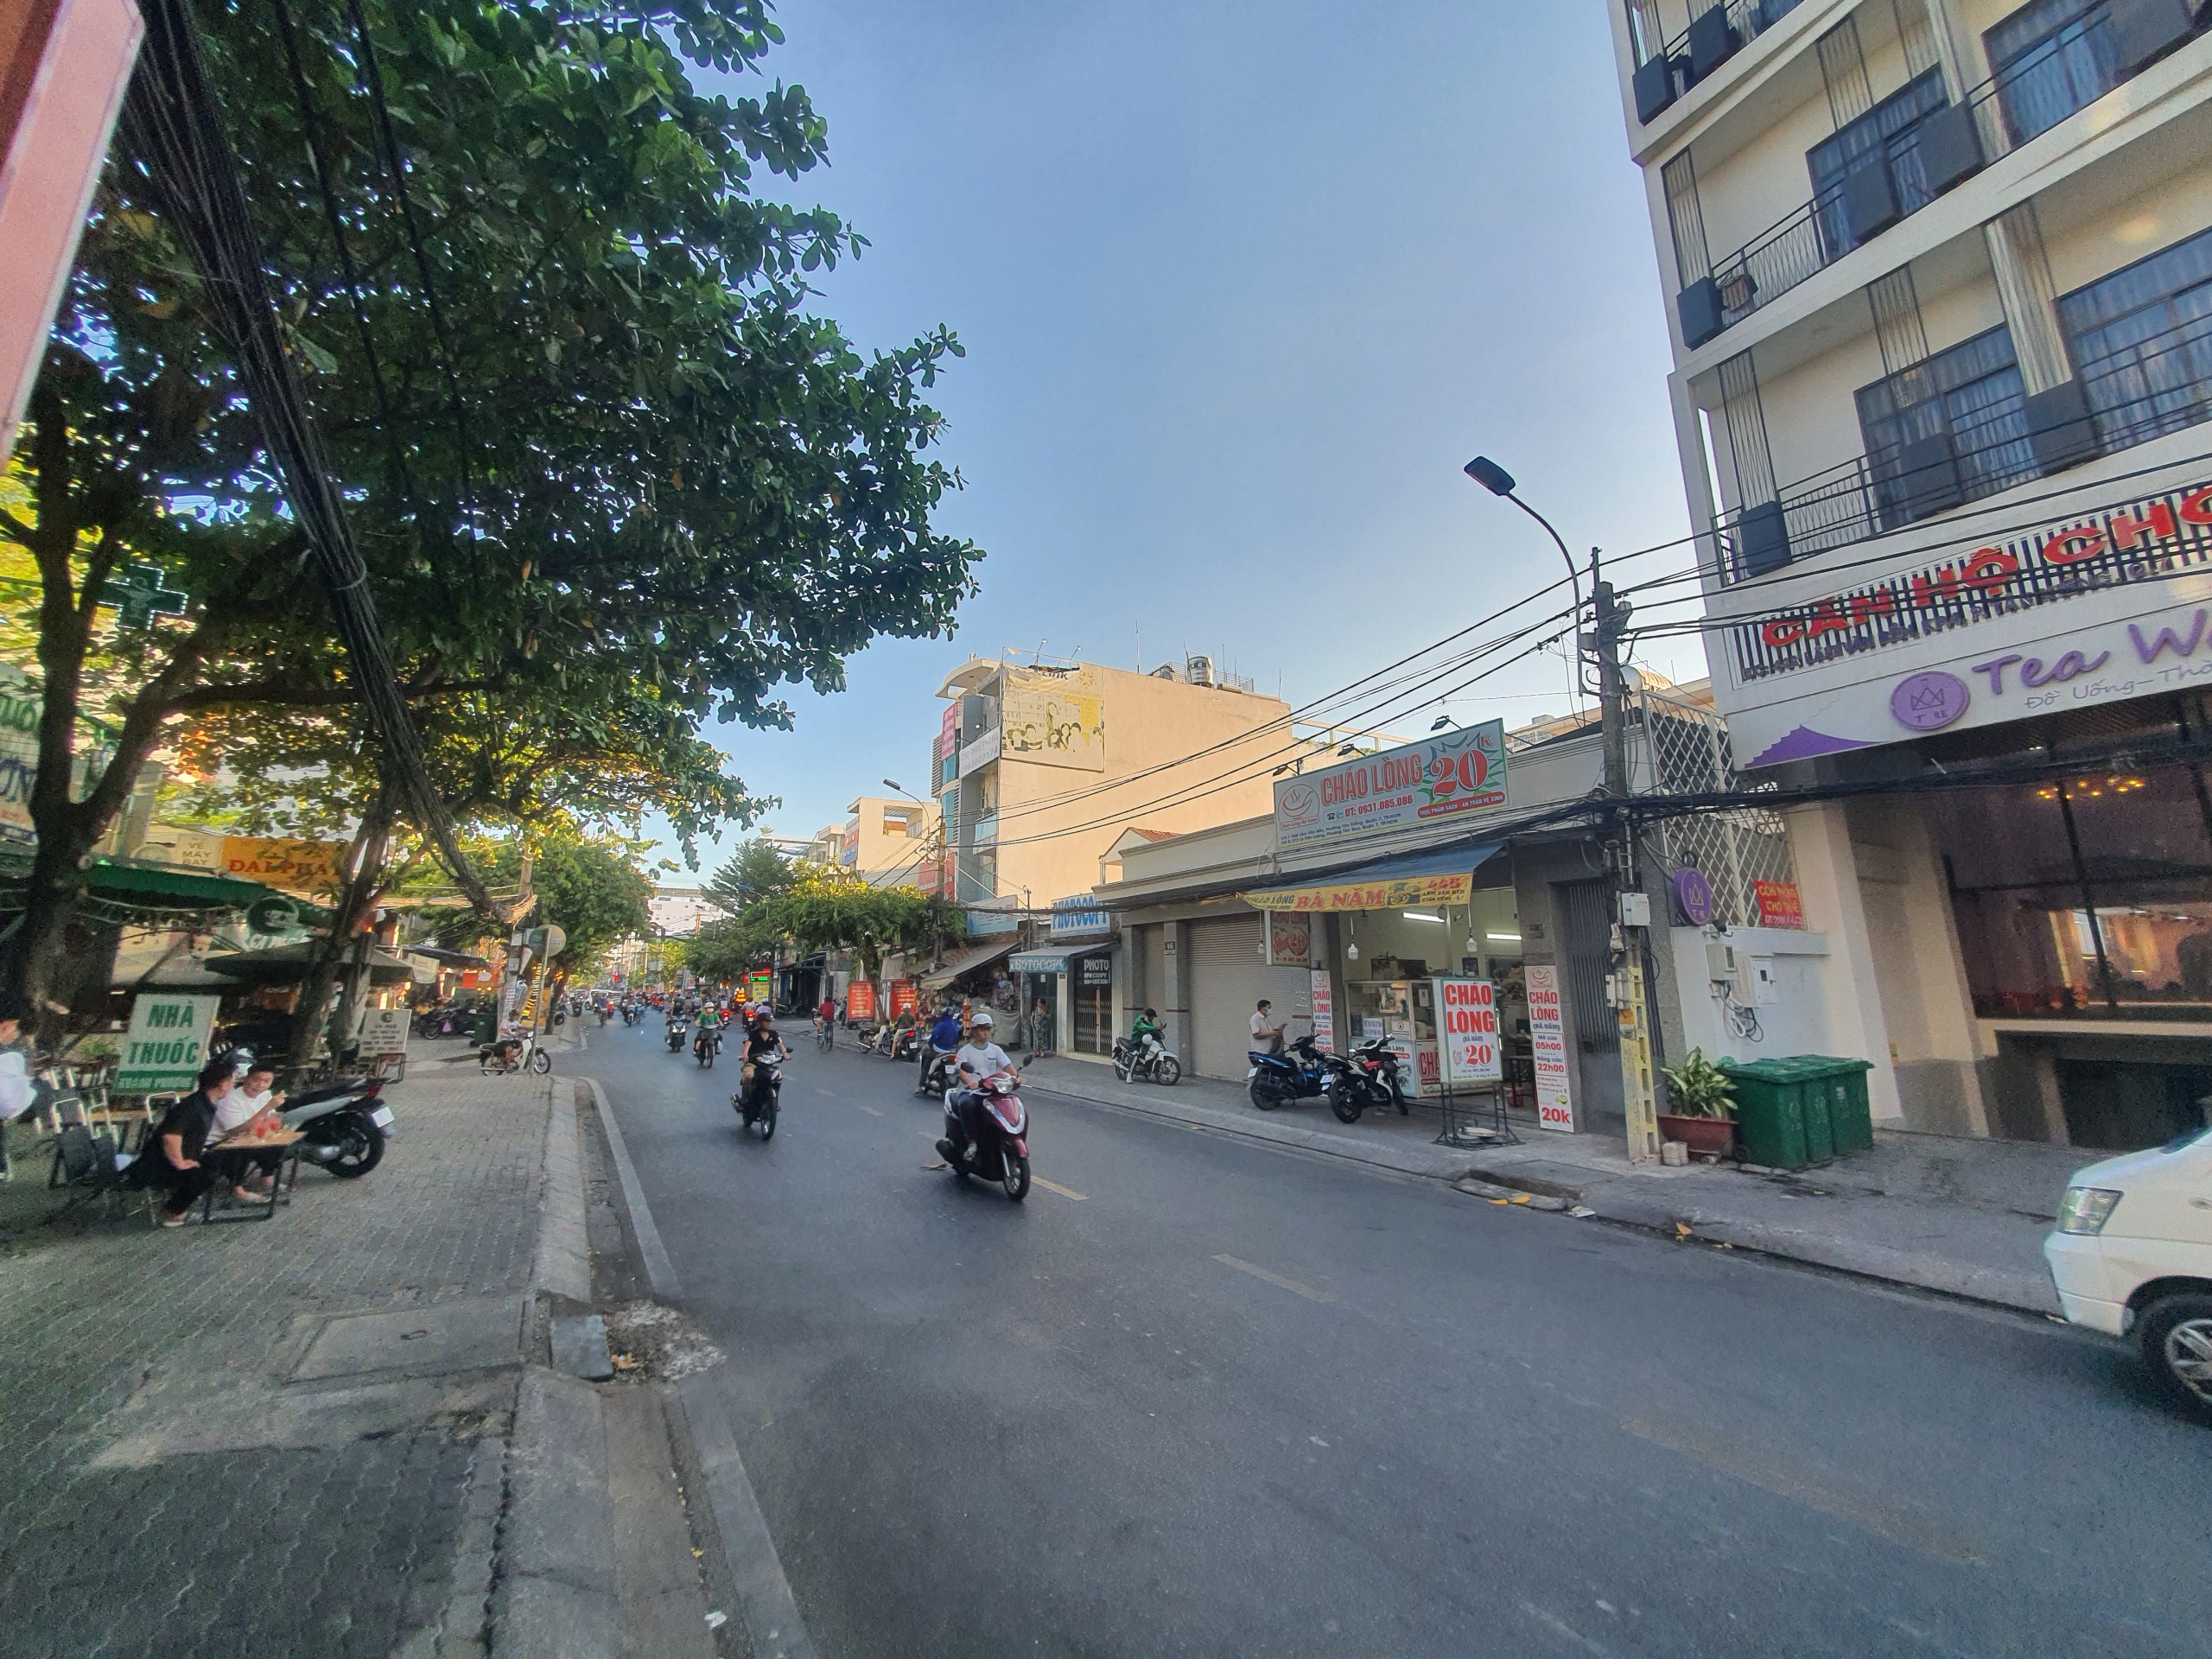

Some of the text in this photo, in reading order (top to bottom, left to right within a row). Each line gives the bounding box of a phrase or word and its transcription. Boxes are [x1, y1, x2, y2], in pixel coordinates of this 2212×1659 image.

[1971, 607, 2212, 696] Tea W
[2022, 690, 2062, 709] Đồ
[1320, 765, 1368, 806] CHÁO
[1373, 752, 1424, 794] LÒNG
[1430, 748, 1489, 798] 20
[1344, 794, 1414, 817] ĐT: 0931.085.086
[1295, 891, 1325, 908] BÀ
[1331, 887, 1385, 908] NĂM
[1765, 900, 1783, 912] CHO
[1084, 958, 1109, 971] PHOTO
[1313, 989, 1331, 1001] CHÁO
[1444, 982, 1492, 1006] CHÁO
[1529, 988, 1558, 1005] CHÁO
[146, 999, 194, 1028] NHÀ
[1313, 1002, 1331, 1014] LÒNG
[1530, 1006, 1560, 1021] LÒNG
[1446, 1007, 1496, 1034] LÒNG
[127, 1035, 200, 1065] THUỐC
[1465, 1043, 1492, 1066] 20
[1535, 1041, 1562, 1051] 05h00
[1537, 1063, 1565, 1073] 22h00
[1541, 1106, 1572, 1124] 20k
